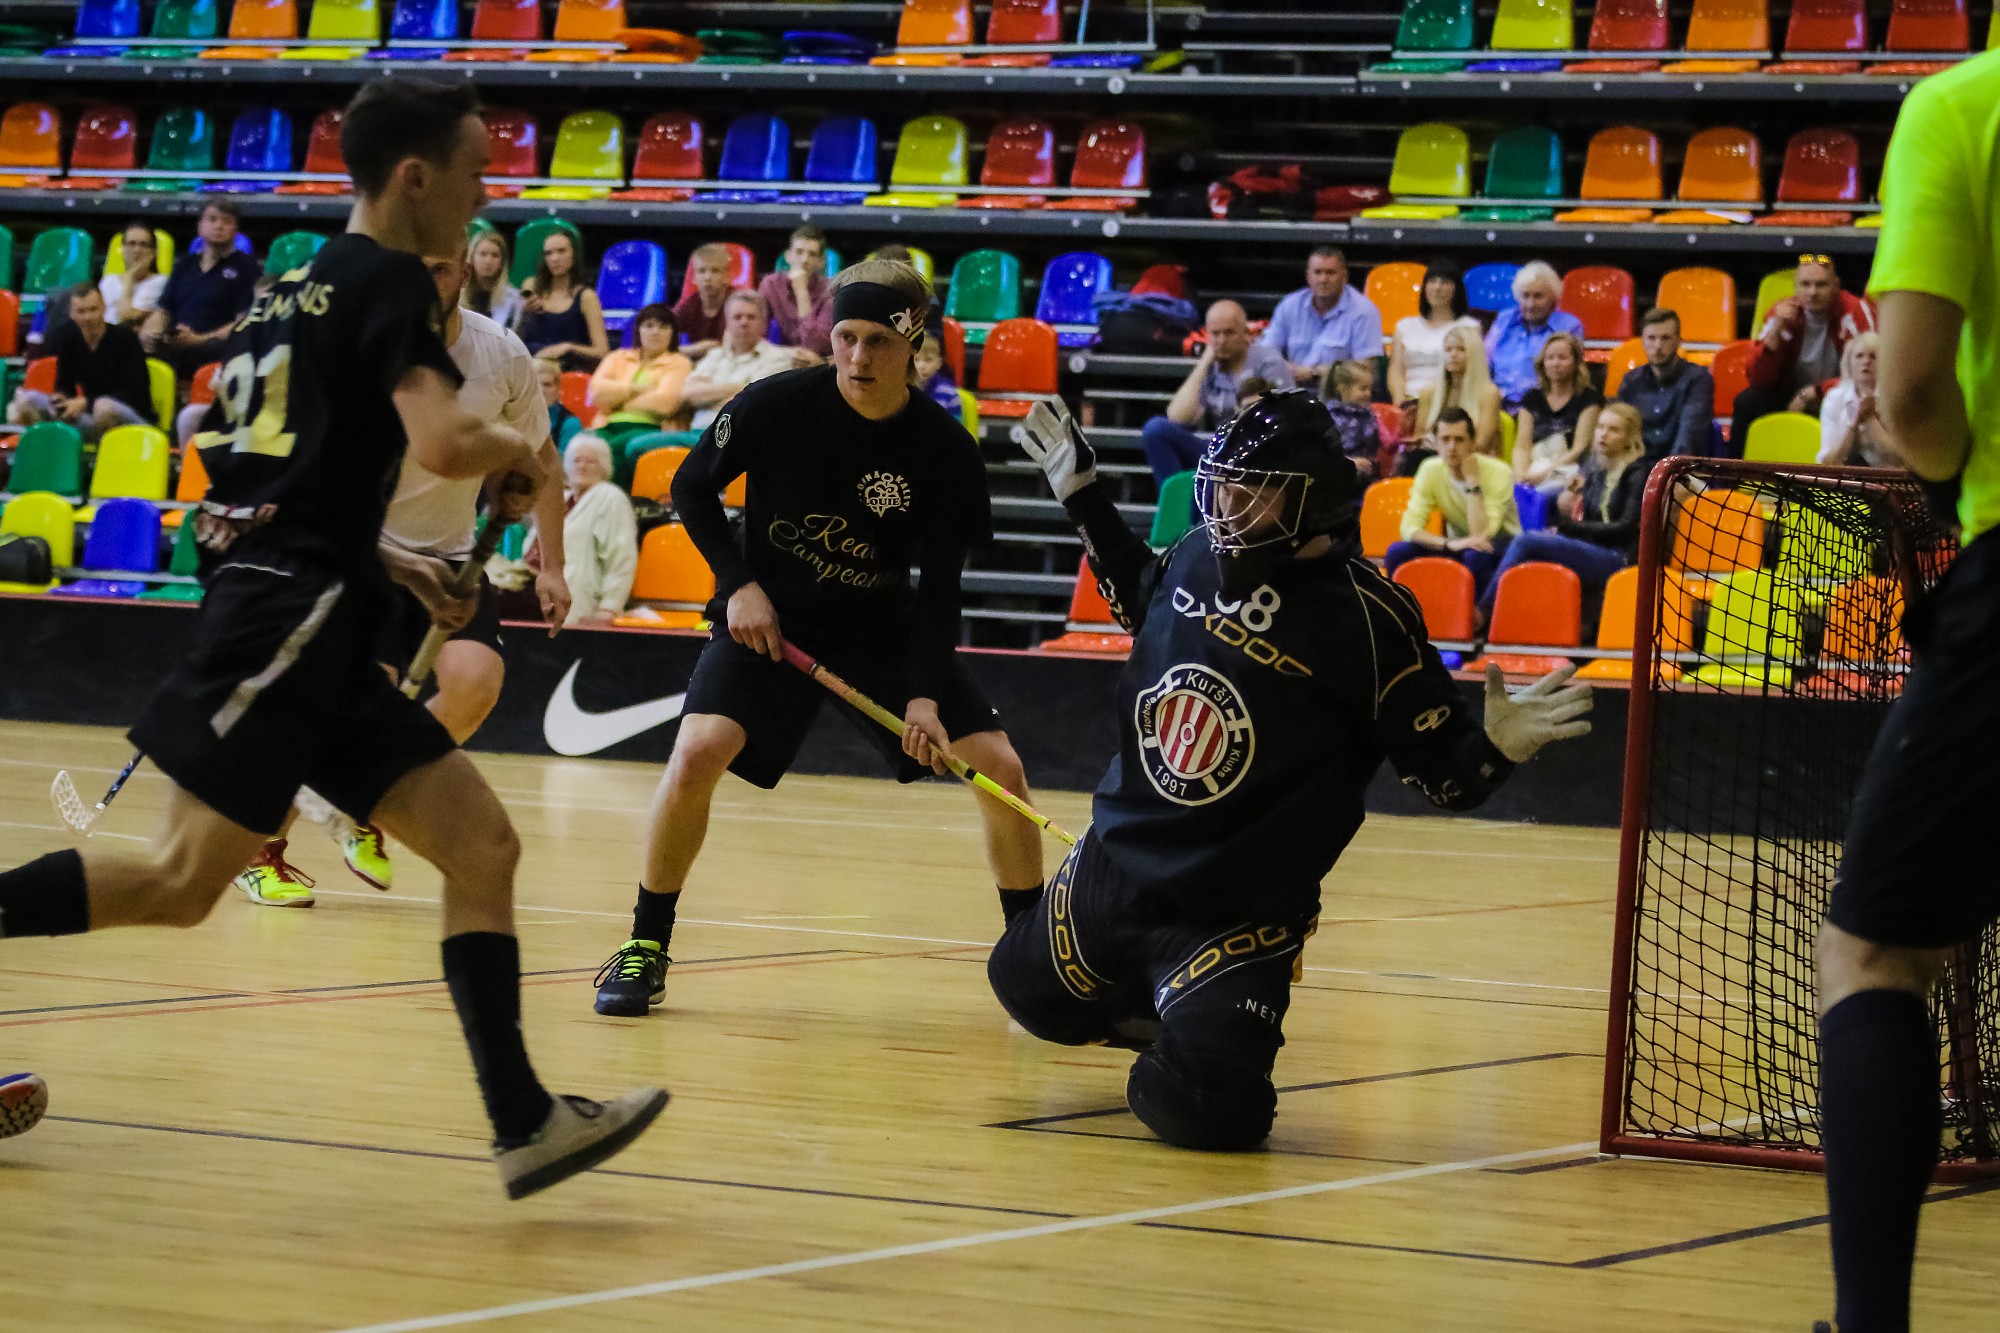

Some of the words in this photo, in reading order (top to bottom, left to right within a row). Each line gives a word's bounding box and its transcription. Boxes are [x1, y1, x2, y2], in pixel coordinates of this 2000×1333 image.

[1186, 671, 1233, 706] Kurši
[1217, 748, 1241, 778] Klubs
[1155, 765, 1188, 797] 1997
